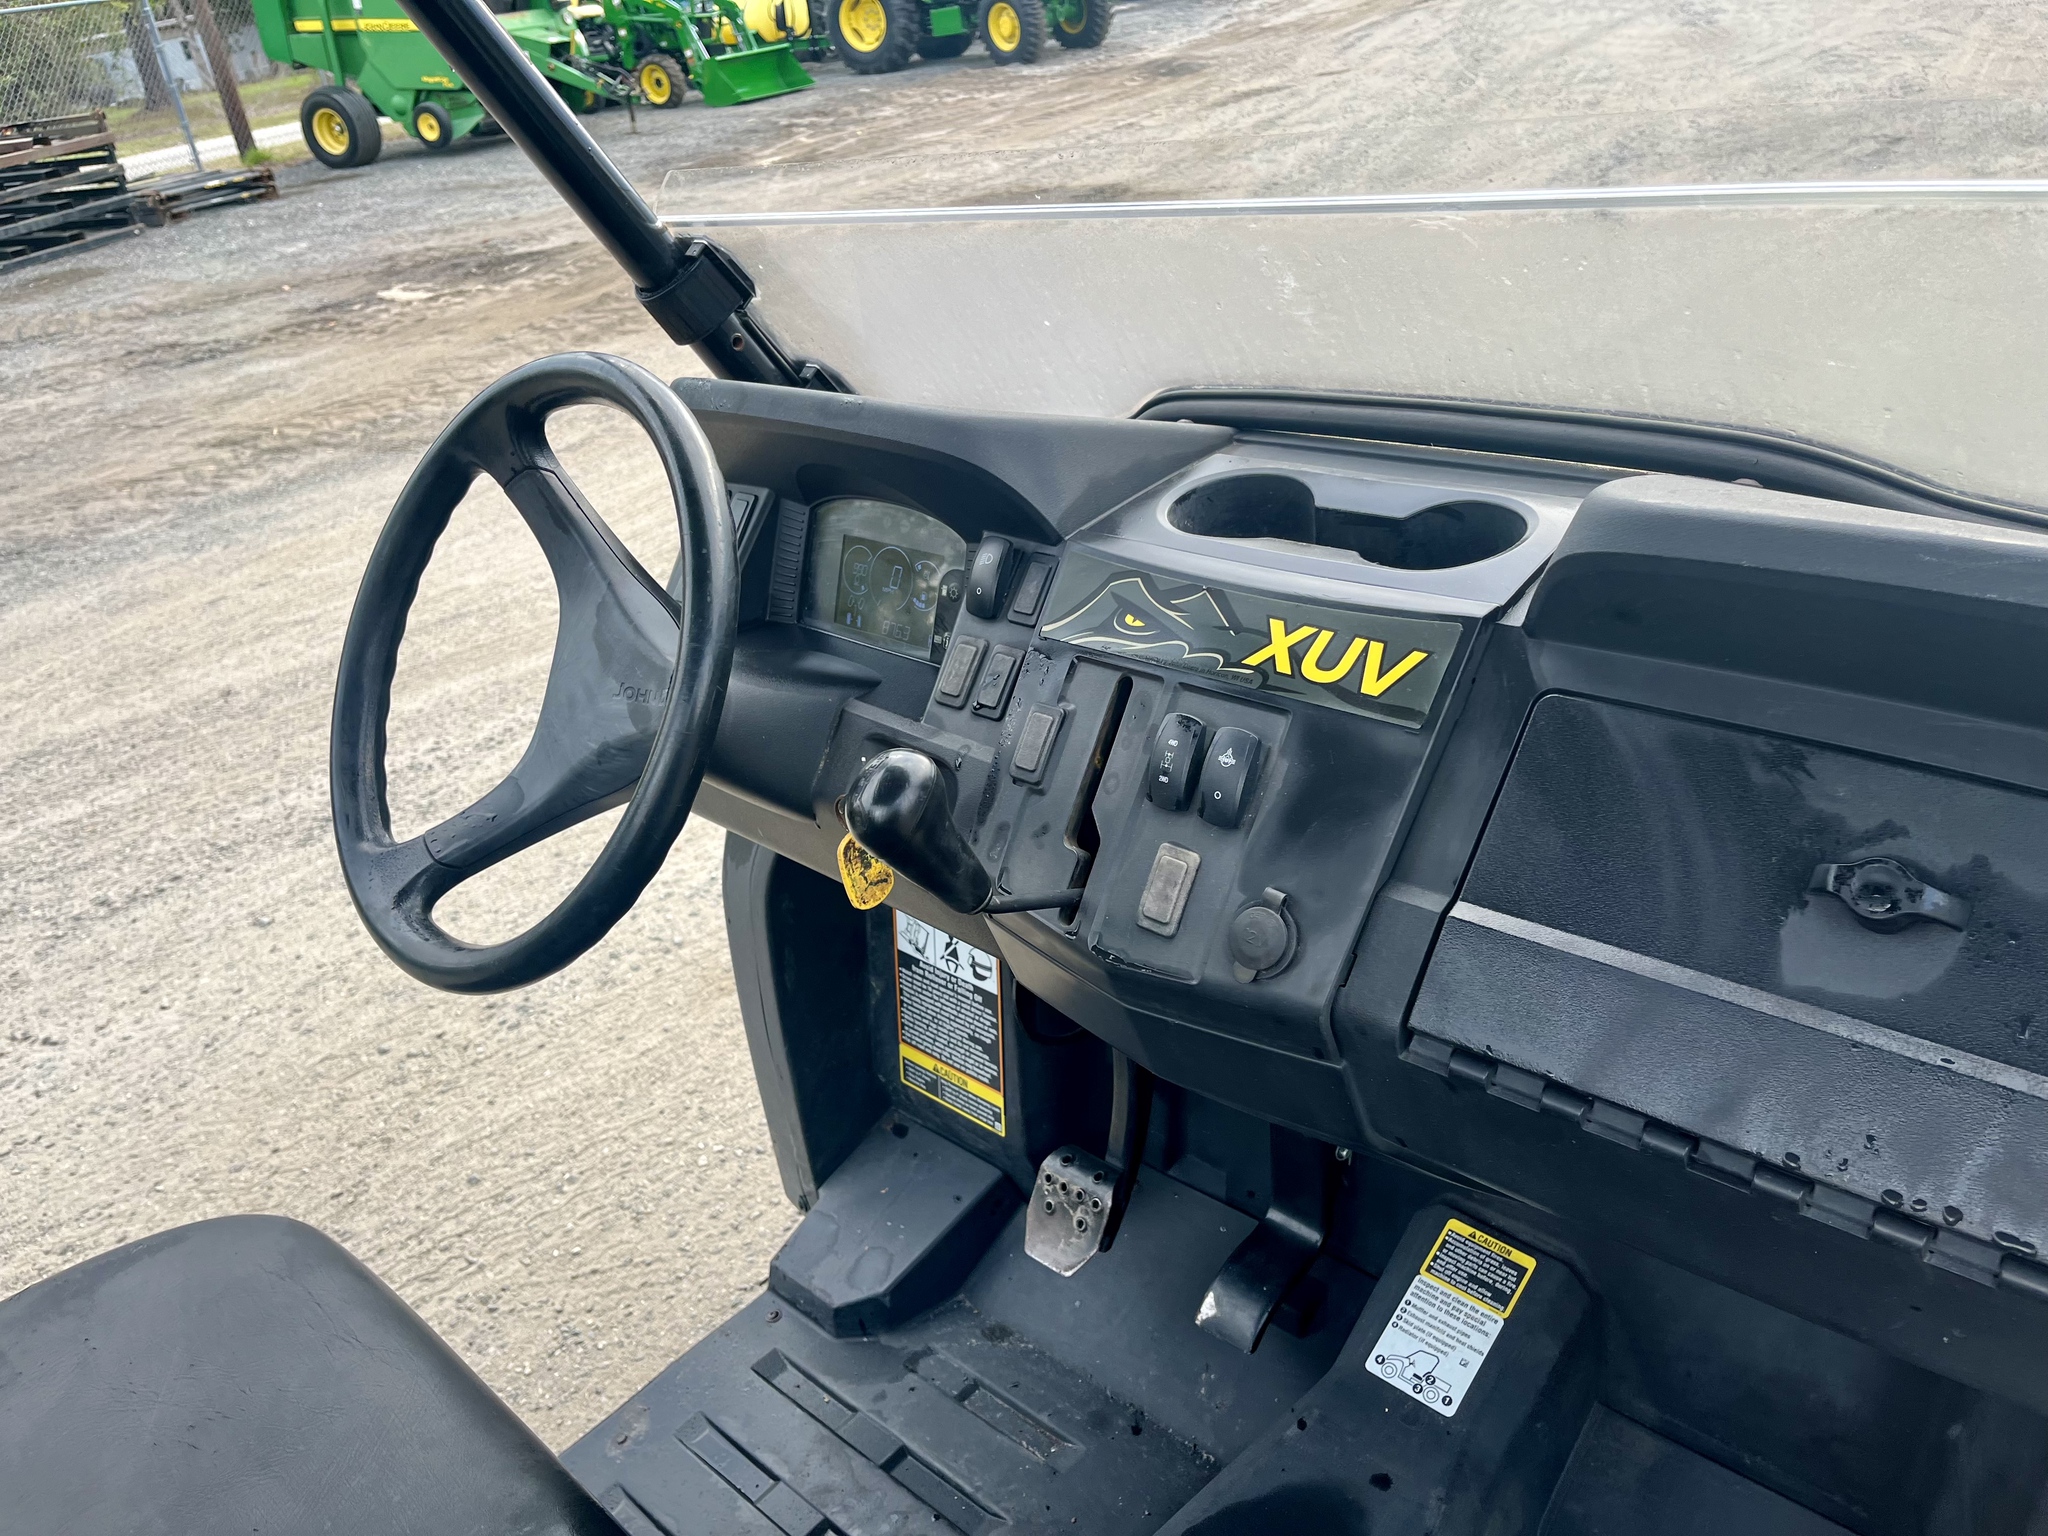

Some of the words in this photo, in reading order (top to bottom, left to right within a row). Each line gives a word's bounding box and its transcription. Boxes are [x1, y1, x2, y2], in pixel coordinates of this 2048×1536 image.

[1241, 617, 1429, 698] XUV
[1240, 676, 1254, 685] USA
[940, 1066, 968, 1088] CAUTION
[1477, 1234, 1512, 1256] CAUTION
[1409, 1291, 1435, 1308] attention
[1444, 1309, 1460, 1321] these
[1461, 1318, 1491, 1337] locations:
[1413, 1284, 1438, 1300] machine
[1439, 1298, 1451, 1307] and
[1451, 1305, 1463, 1315] pay
[1463, 1311, 1486, 1326] special
[1416, 1277, 1439, 1293] Inspect
[1439, 1289, 1451, 1298] and
[1451, 1295, 1468, 1308] clean
[1469, 1305, 1479, 1313] the
[1480, 1311, 1498, 1323] entire
[1402, 1318, 1413, 1326] Skid
[1413, 1324, 1425, 1334] plate
[1431, 1335, 1456, 1352] equipped)
[1406, 1311, 1425, 1323] Exhaust
[1425, 1320, 1445, 1334] manifold
[1446, 1332, 1455, 1340] and
[1455, 1337, 1467, 1346] heat
[1467, 1343, 1484, 1355] shields
[1411, 1303, 1428, 1315] Muffler
[1438, 1318, 1457, 1331] exhaust
[1456, 1328, 1470, 1339] pipes
[1398, 1326, 1418, 1339] Radiator
[1424, 1341, 1449, 1357] equipped)
